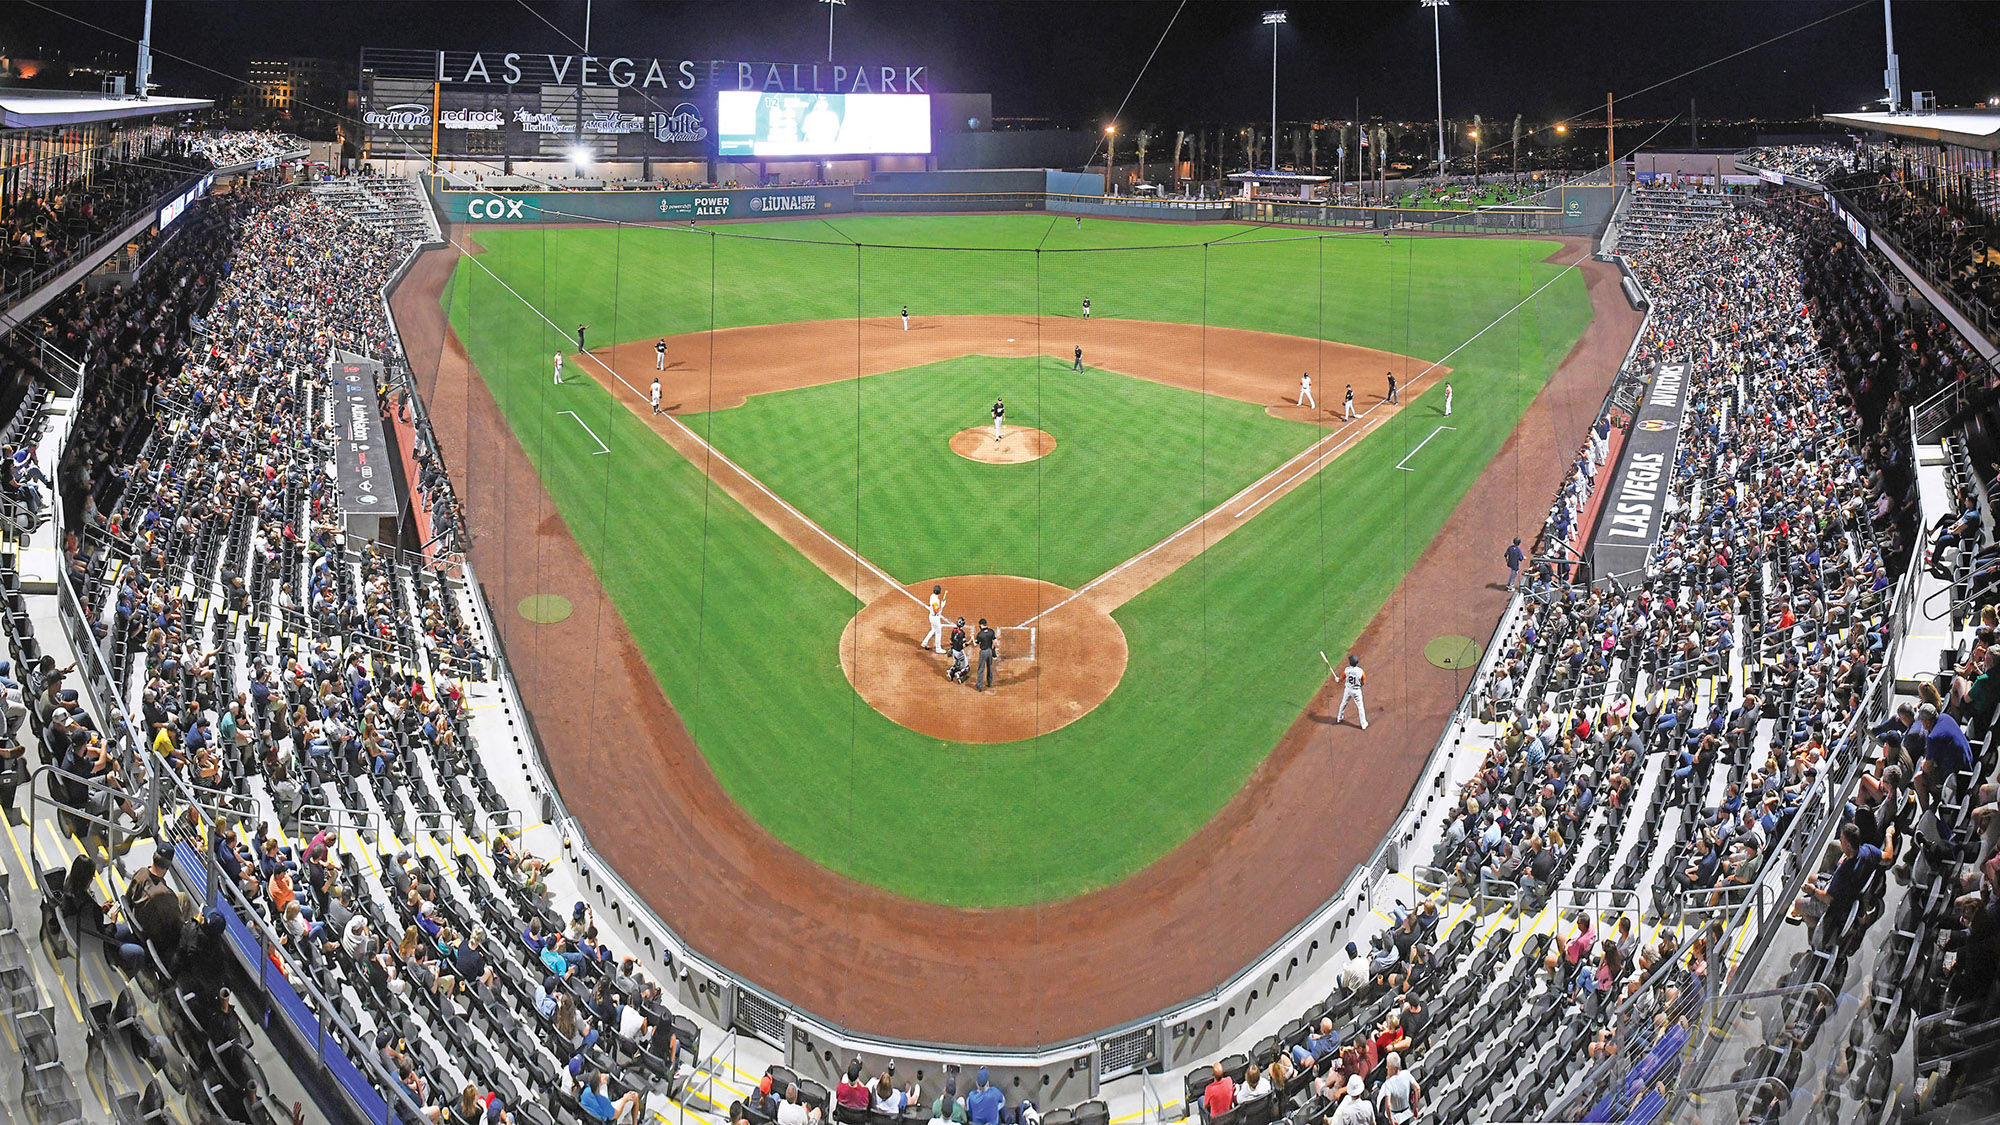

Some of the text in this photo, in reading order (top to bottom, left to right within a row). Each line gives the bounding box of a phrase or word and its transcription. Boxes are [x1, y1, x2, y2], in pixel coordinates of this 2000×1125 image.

[438, 51, 925, 93] LAS VEGAS BALLPARK
[441, 107, 503, 121] red rock
[468, 198, 524, 219] COX
[694, 197, 730, 207] POWER
[801, 202, 816, 210] 872
[696, 206, 728, 216] ALLEY
[1650, 365, 1685, 408] AVIATORS
[1608, 452, 1665, 539] LAS VEGAS
